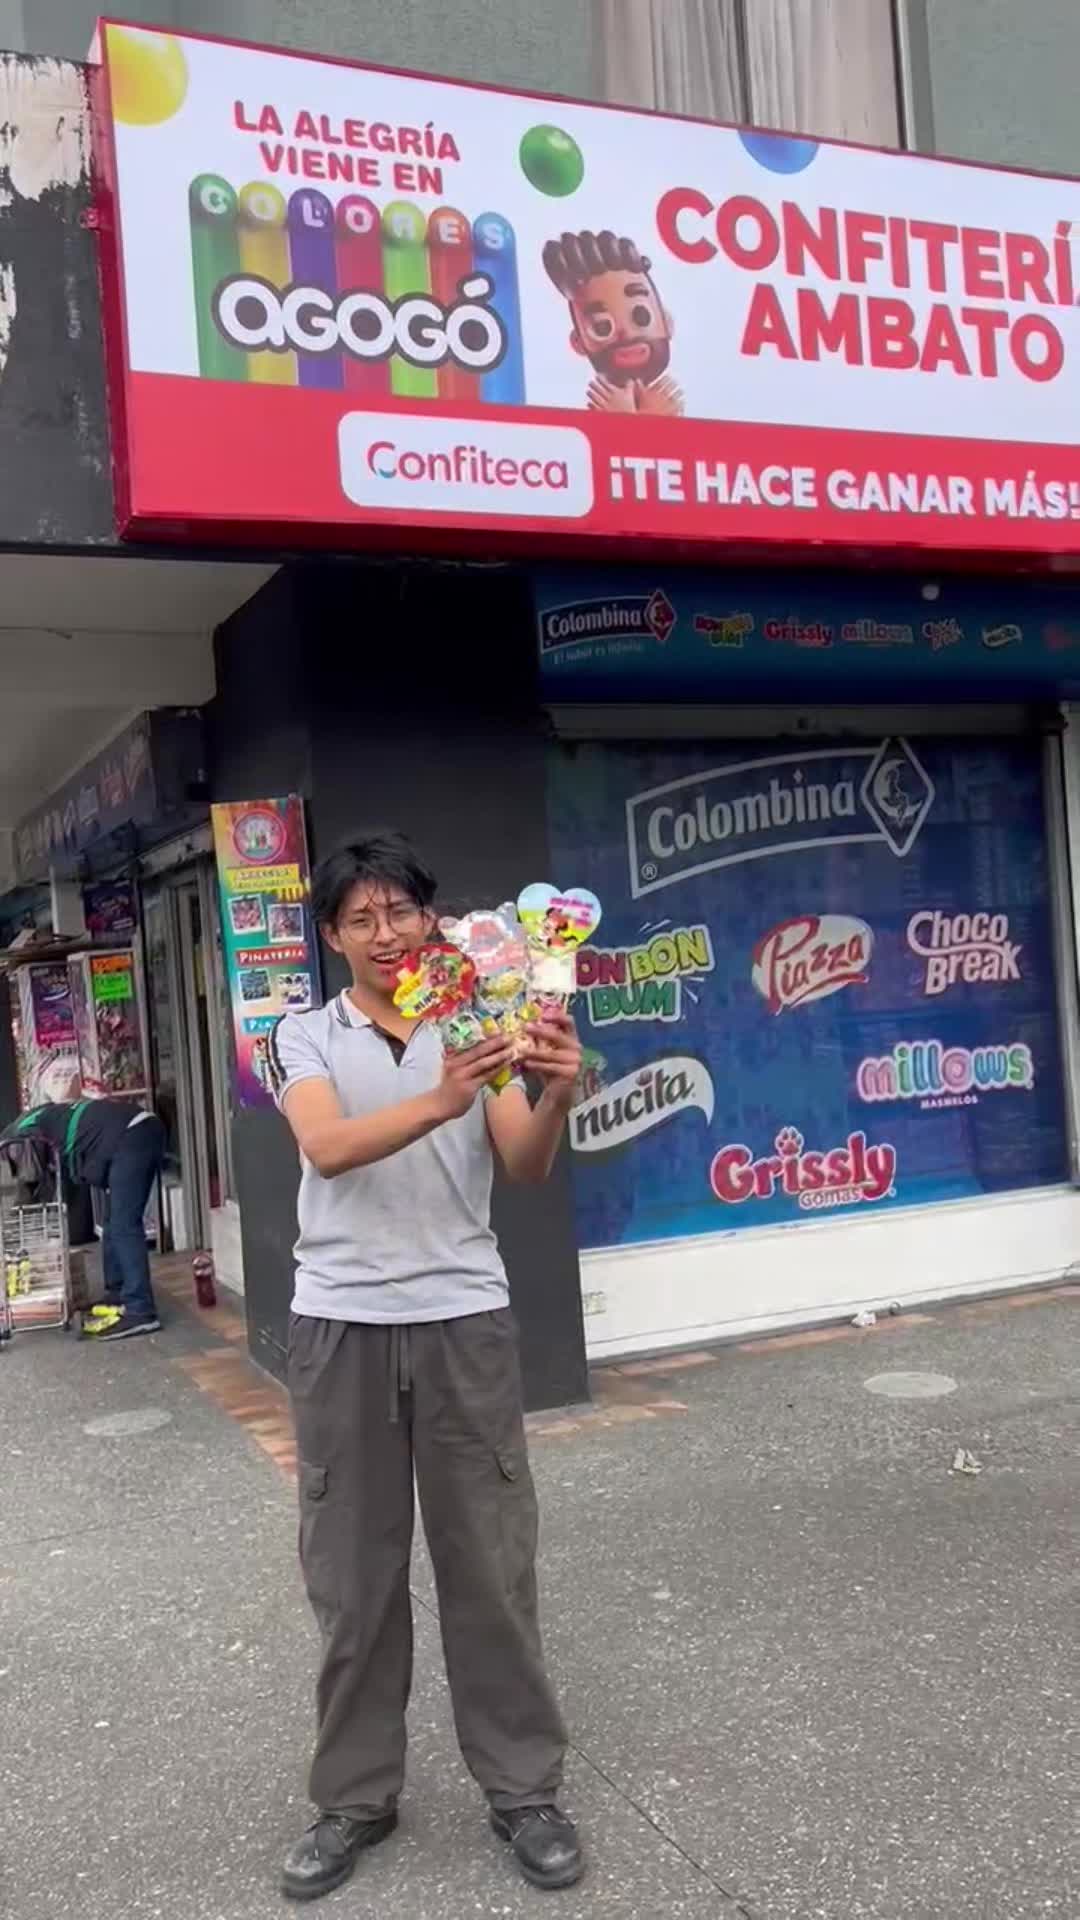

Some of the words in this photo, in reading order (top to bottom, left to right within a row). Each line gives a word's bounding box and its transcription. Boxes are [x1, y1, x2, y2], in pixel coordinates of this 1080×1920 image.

[234, 100, 284, 136] LA
[295, 110, 460, 162] ALEGRÍA
[259, 141, 382, 187] VIENE
[393, 162, 443, 195] EN
[656, 187, 1080, 307] CONFITERÍ
[740, 283, 1065, 382] AMBATO
[367, 440, 569, 489] Confiteca
[610, 456, 685, 501] ¡TE
[695, 460, 818, 507] HACE
[826, 469, 976, 516] GANAR
[984, 470, 1080, 520] MÁS!
[546, 604, 642, 639] Colombina
[648, 769, 857, 859] Colombina
[576, 949, 628, 987] ON
[628, 928, 710, 983] BON
[753, 916, 865, 1013] Piazza
[591, 980, 678, 1022] BUM
[858, 1041, 1033, 1102] millows
[576, 1068, 695, 1143] nucita
[711, 1129, 896, 1203] Grissly
